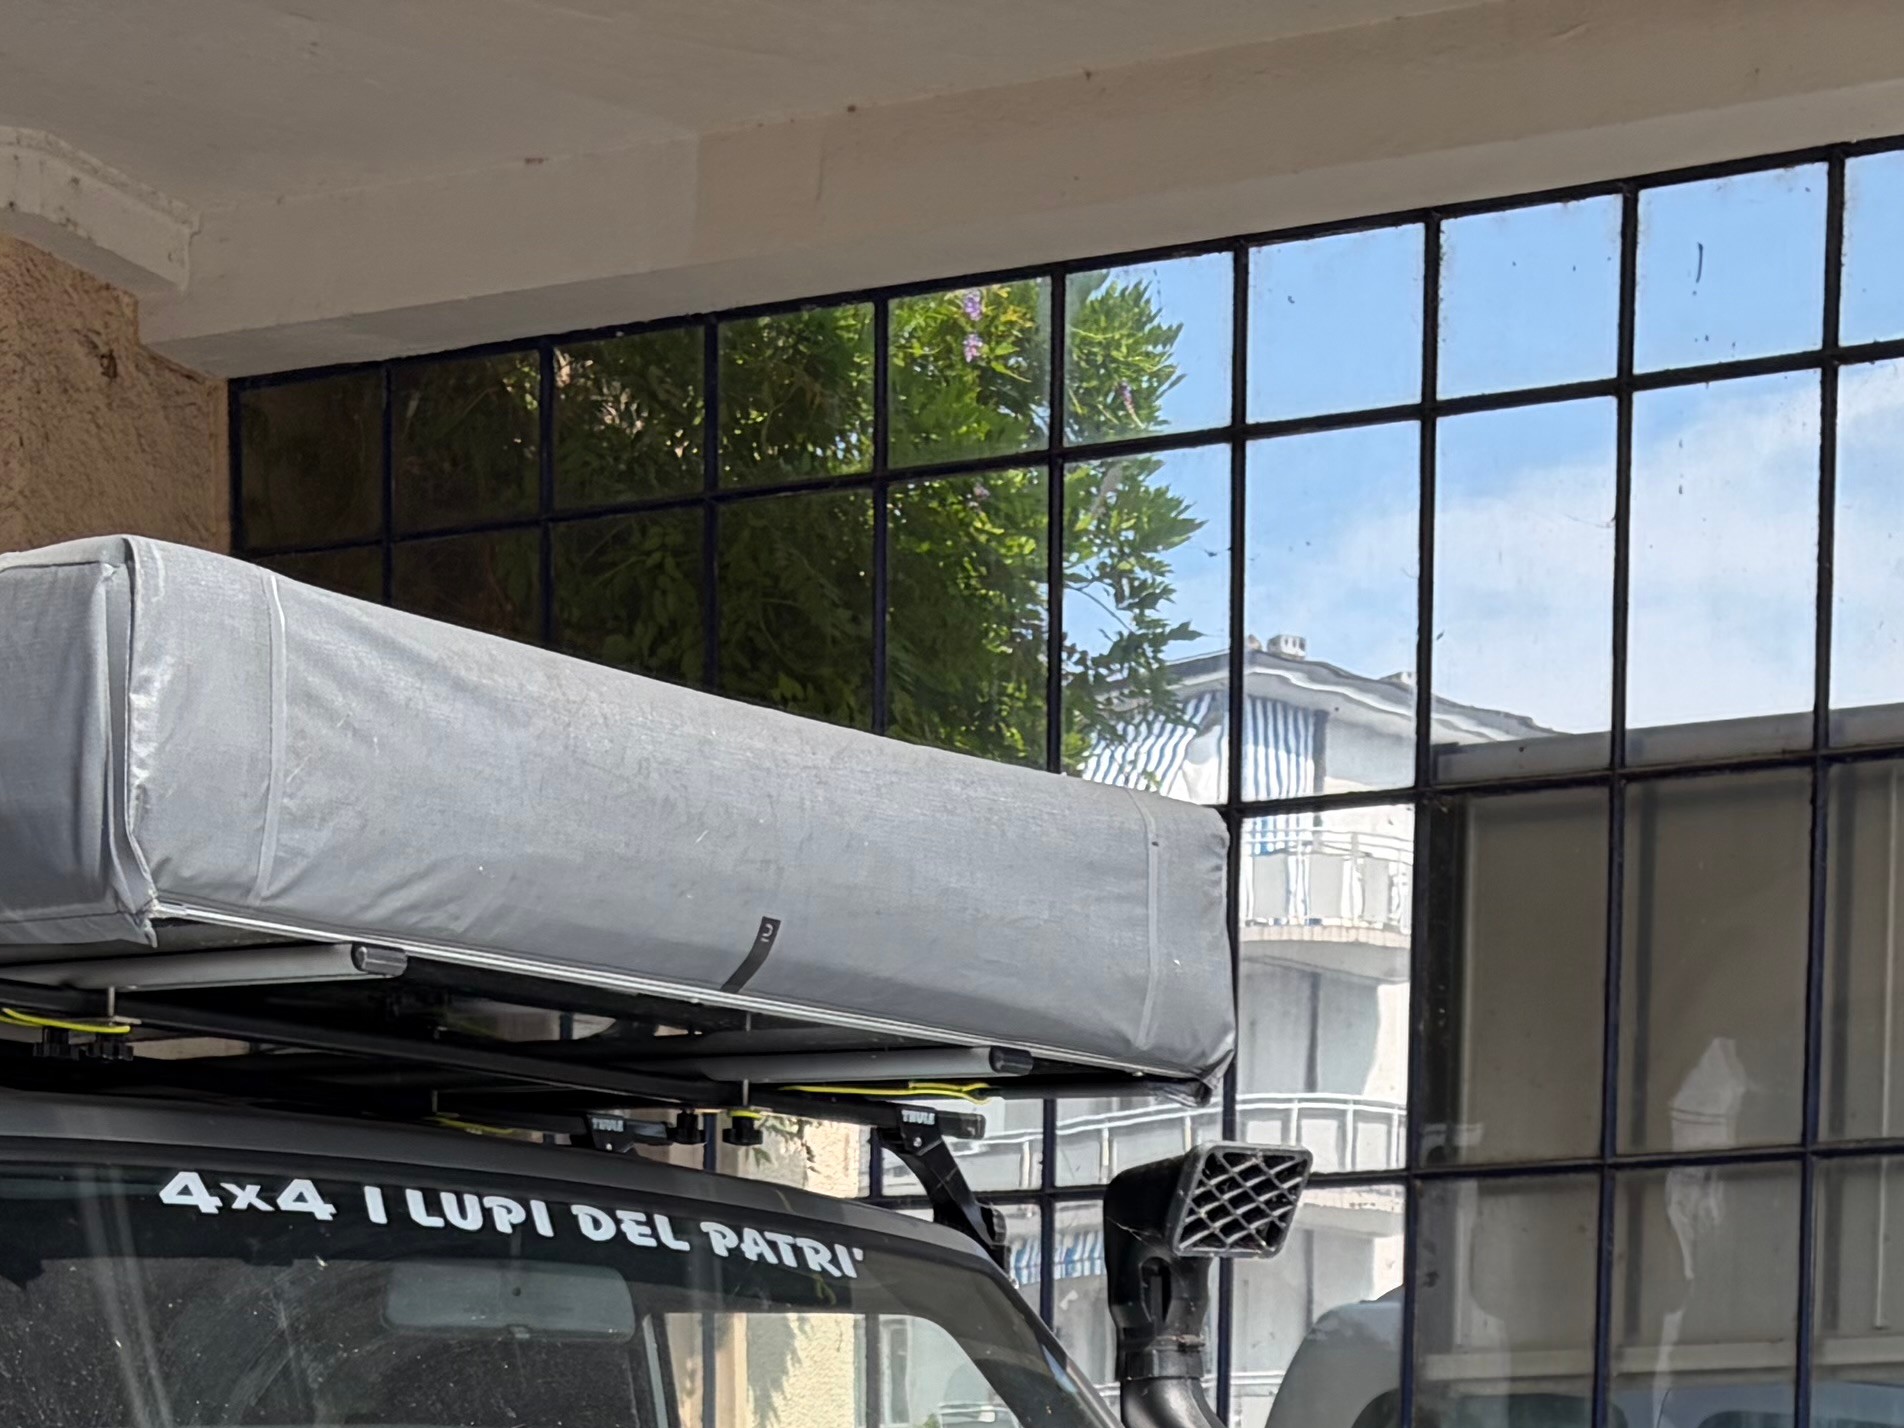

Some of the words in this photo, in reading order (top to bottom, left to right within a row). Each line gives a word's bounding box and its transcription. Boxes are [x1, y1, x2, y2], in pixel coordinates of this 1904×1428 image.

[159, 1171, 337, 1221] 4x4
[363, 1185, 388, 1224] I
[405, 1188, 555, 1238] LUPI
[570, 1204, 691, 1251] DEL
[700, 1221, 864, 1279] PATRI'
